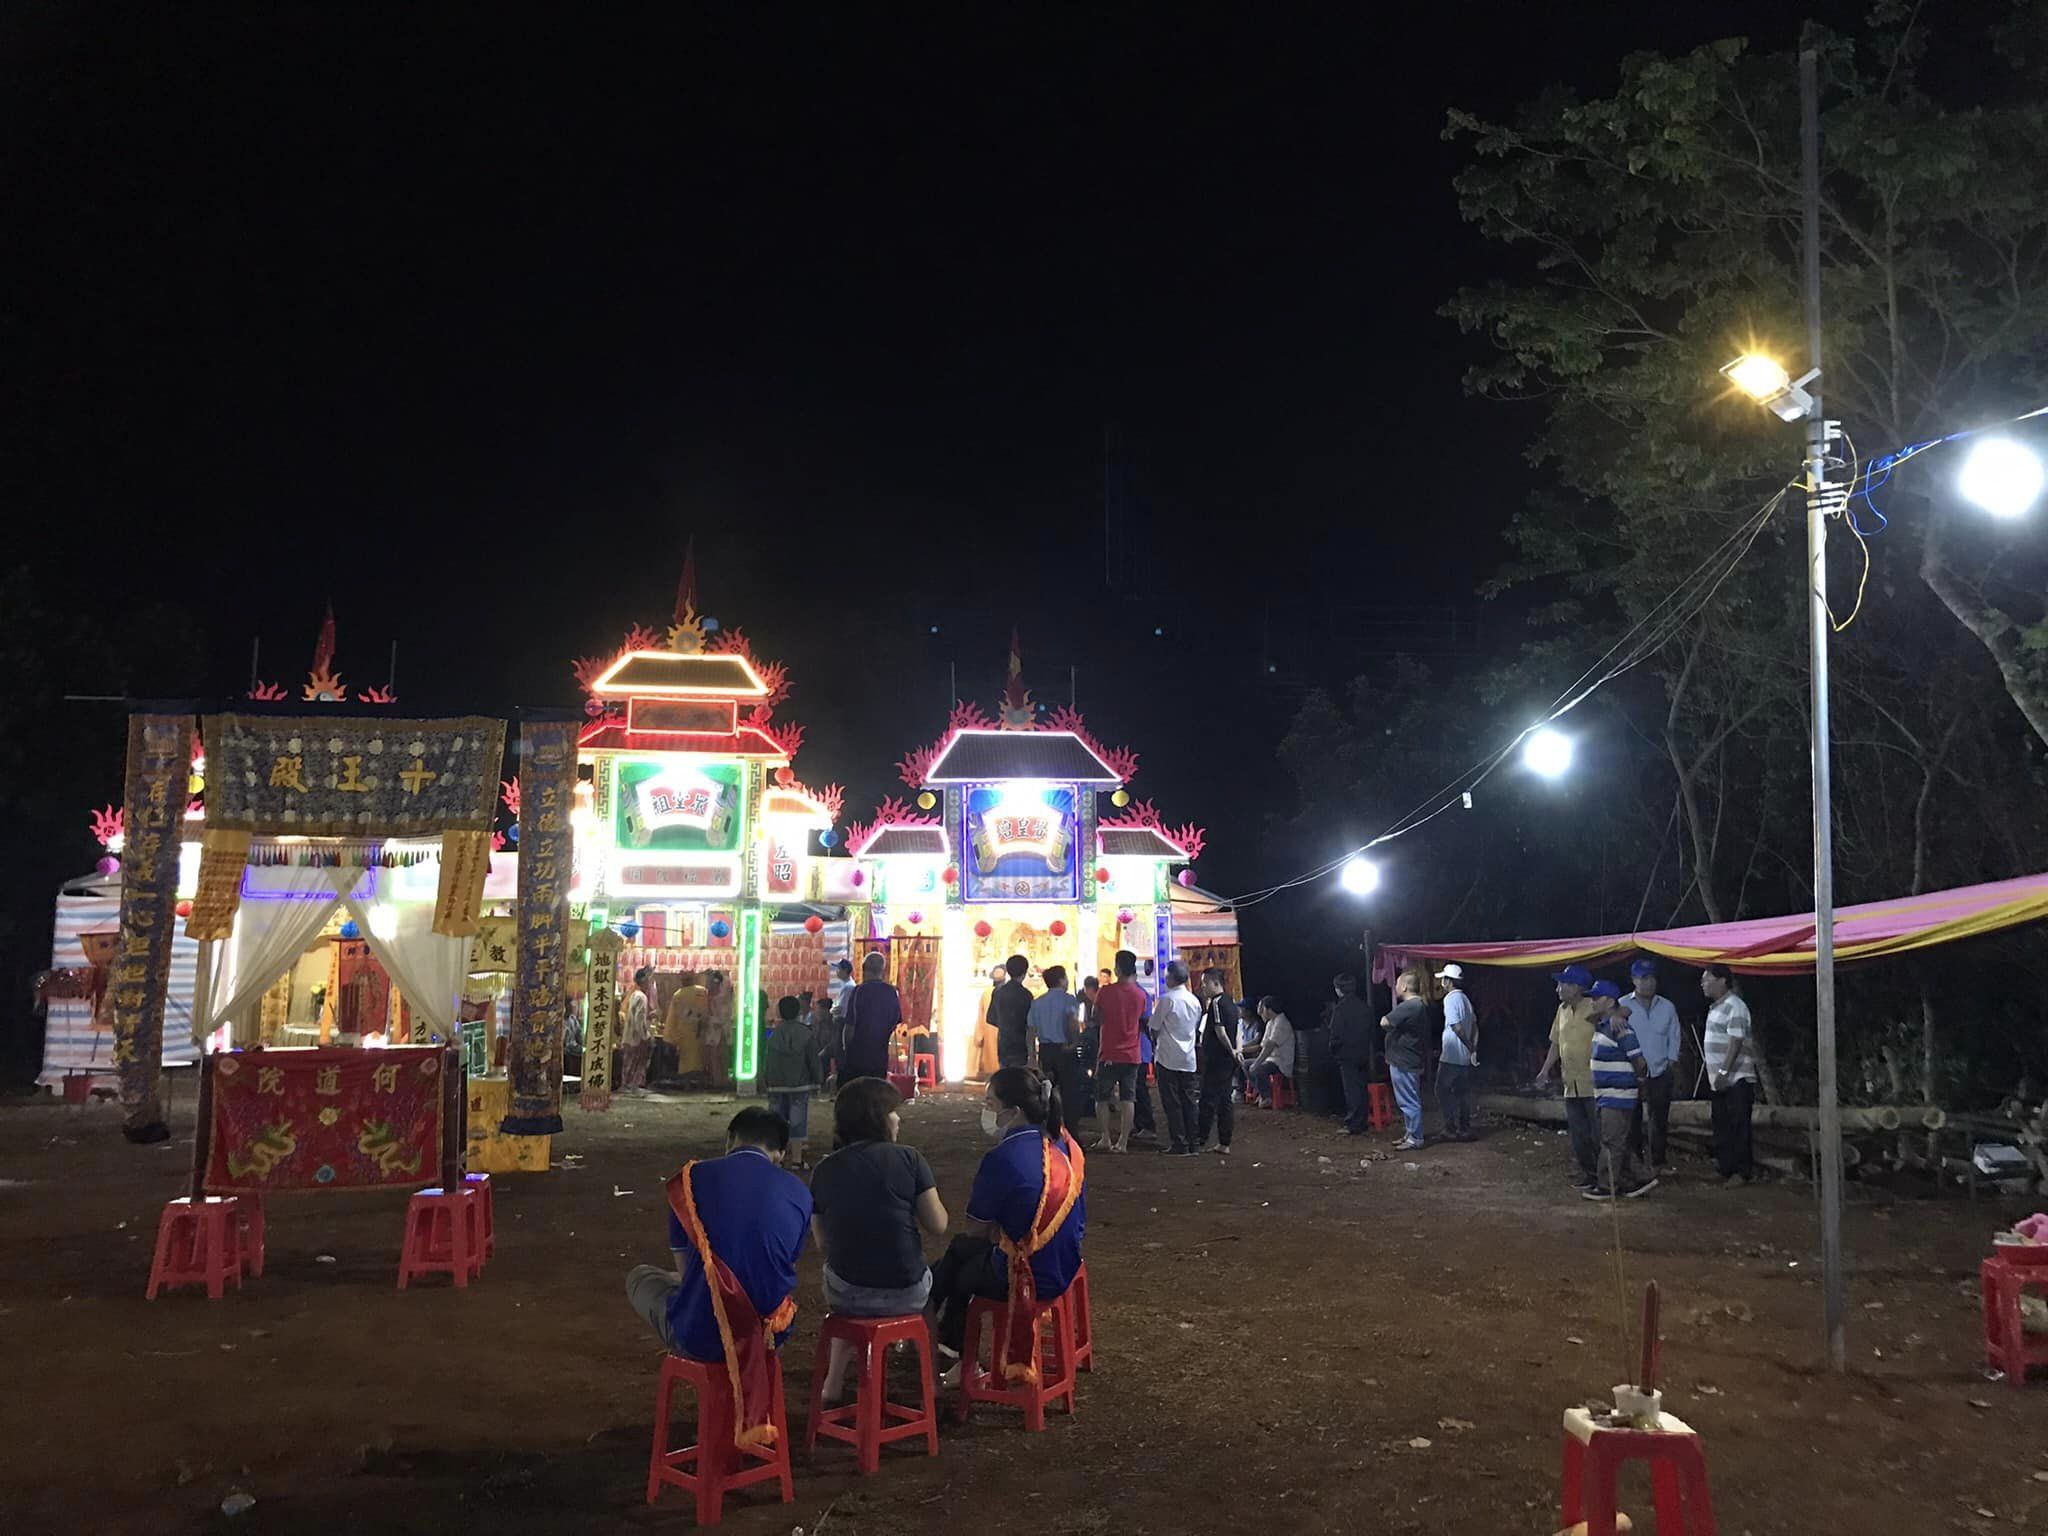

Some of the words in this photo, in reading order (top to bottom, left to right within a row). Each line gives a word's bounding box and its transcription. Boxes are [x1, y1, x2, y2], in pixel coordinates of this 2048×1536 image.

[268, 755, 437, 796] 十王殿
[256, 1062, 404, 1096] 何道院
